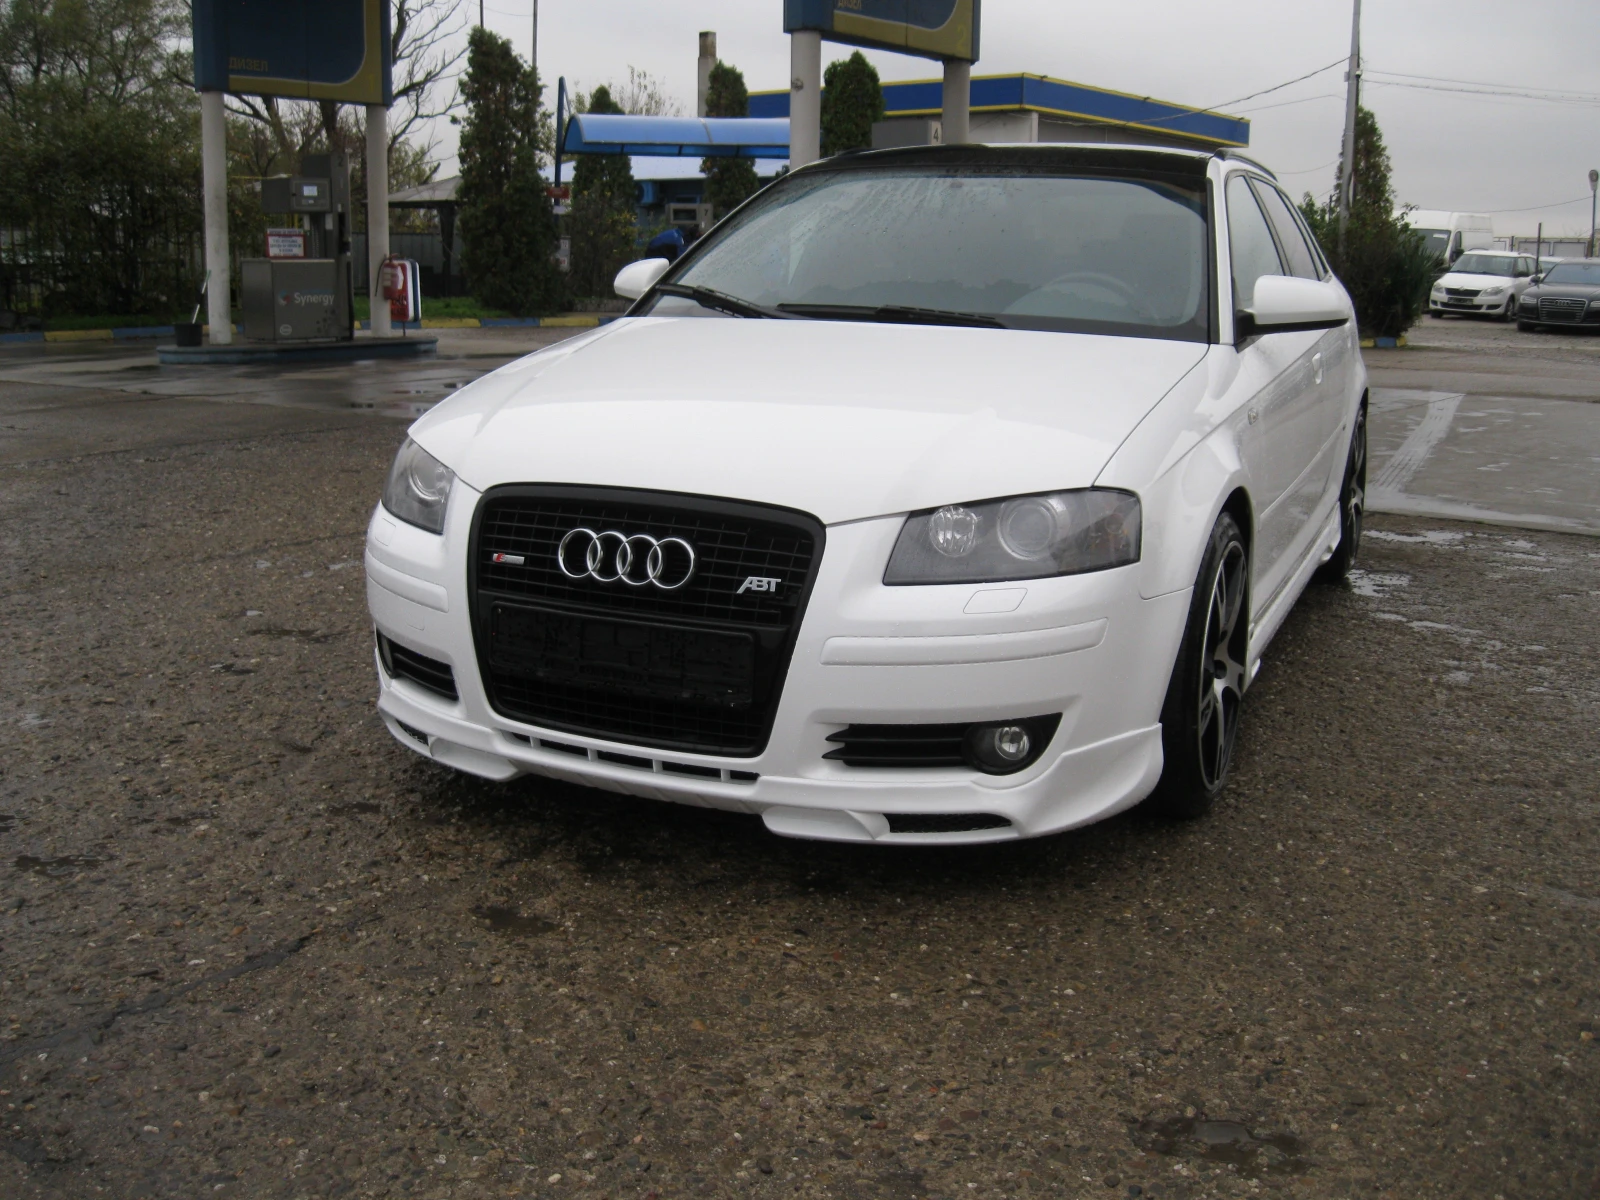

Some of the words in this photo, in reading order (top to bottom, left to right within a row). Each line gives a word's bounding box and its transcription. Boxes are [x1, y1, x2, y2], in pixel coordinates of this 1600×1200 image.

[957, 24, 967, 51] 2
[229, 57, 268, 72] ДИЗЕЛ
[933, 127, 939, 142] 4
[294, 292, 335, 306] Synergy
[736, 576, 782, 594] ABT
